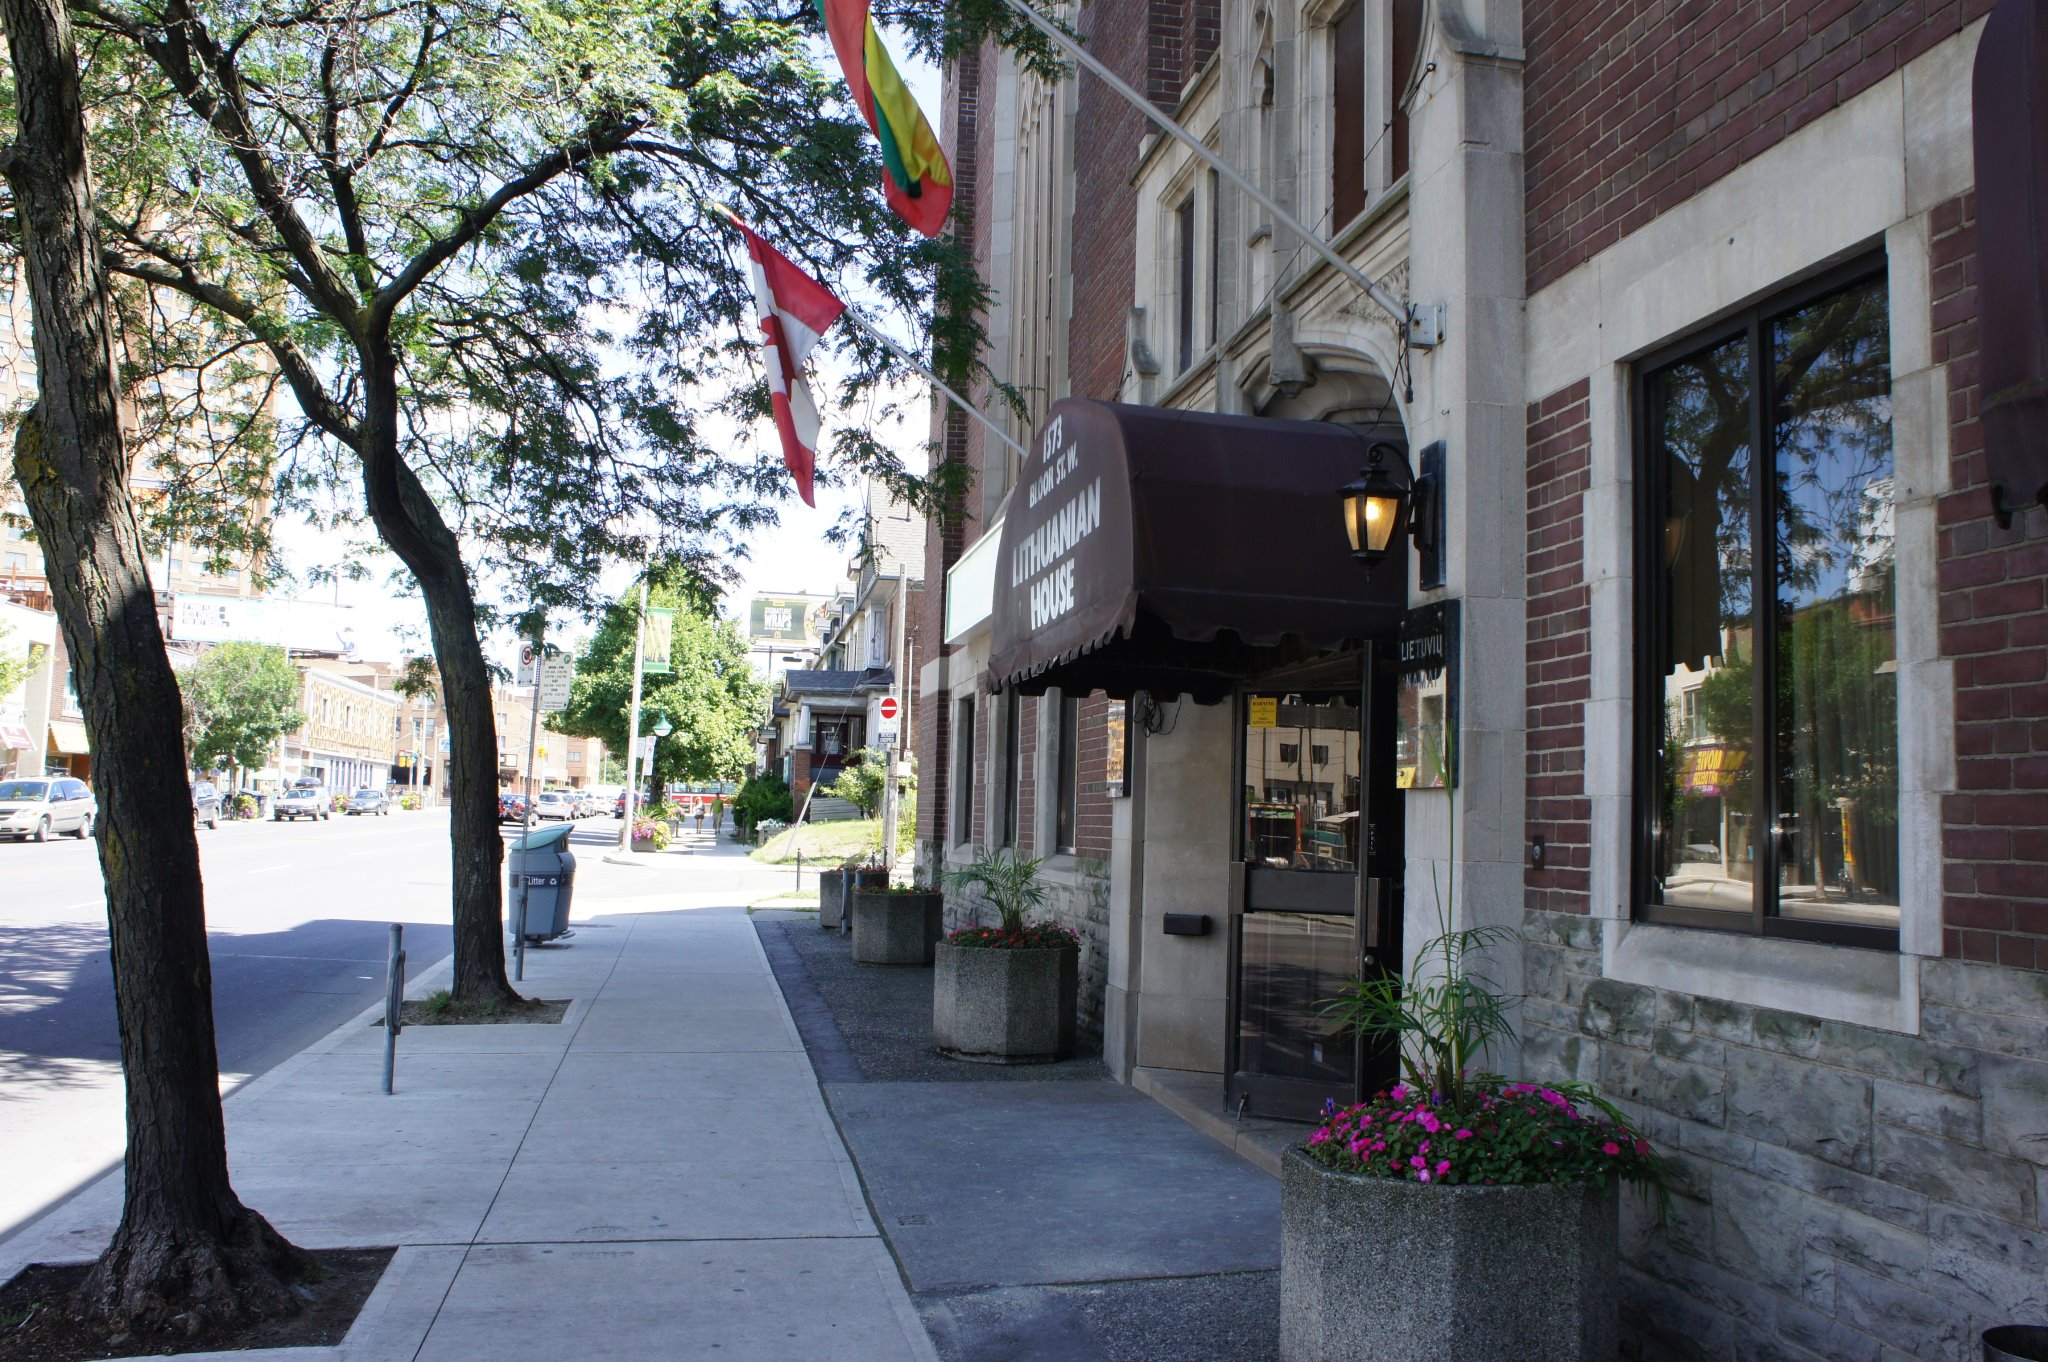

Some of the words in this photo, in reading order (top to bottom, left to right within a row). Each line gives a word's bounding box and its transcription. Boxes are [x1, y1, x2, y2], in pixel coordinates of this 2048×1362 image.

[1043, 413, 1062, 464] 1573
[1029, 465, 1054, 509] BLOOR
[1056, 453, 1067, 485] ST.
[1067, 441, 1078, 474] W.
[1012, 475, 1101, 589] LITHUANIAN
[765, 613, 792, 628] WRAPS
[1030, 558, 1075, 631] HOUSE
[528, 876, 545, 885] Litter
